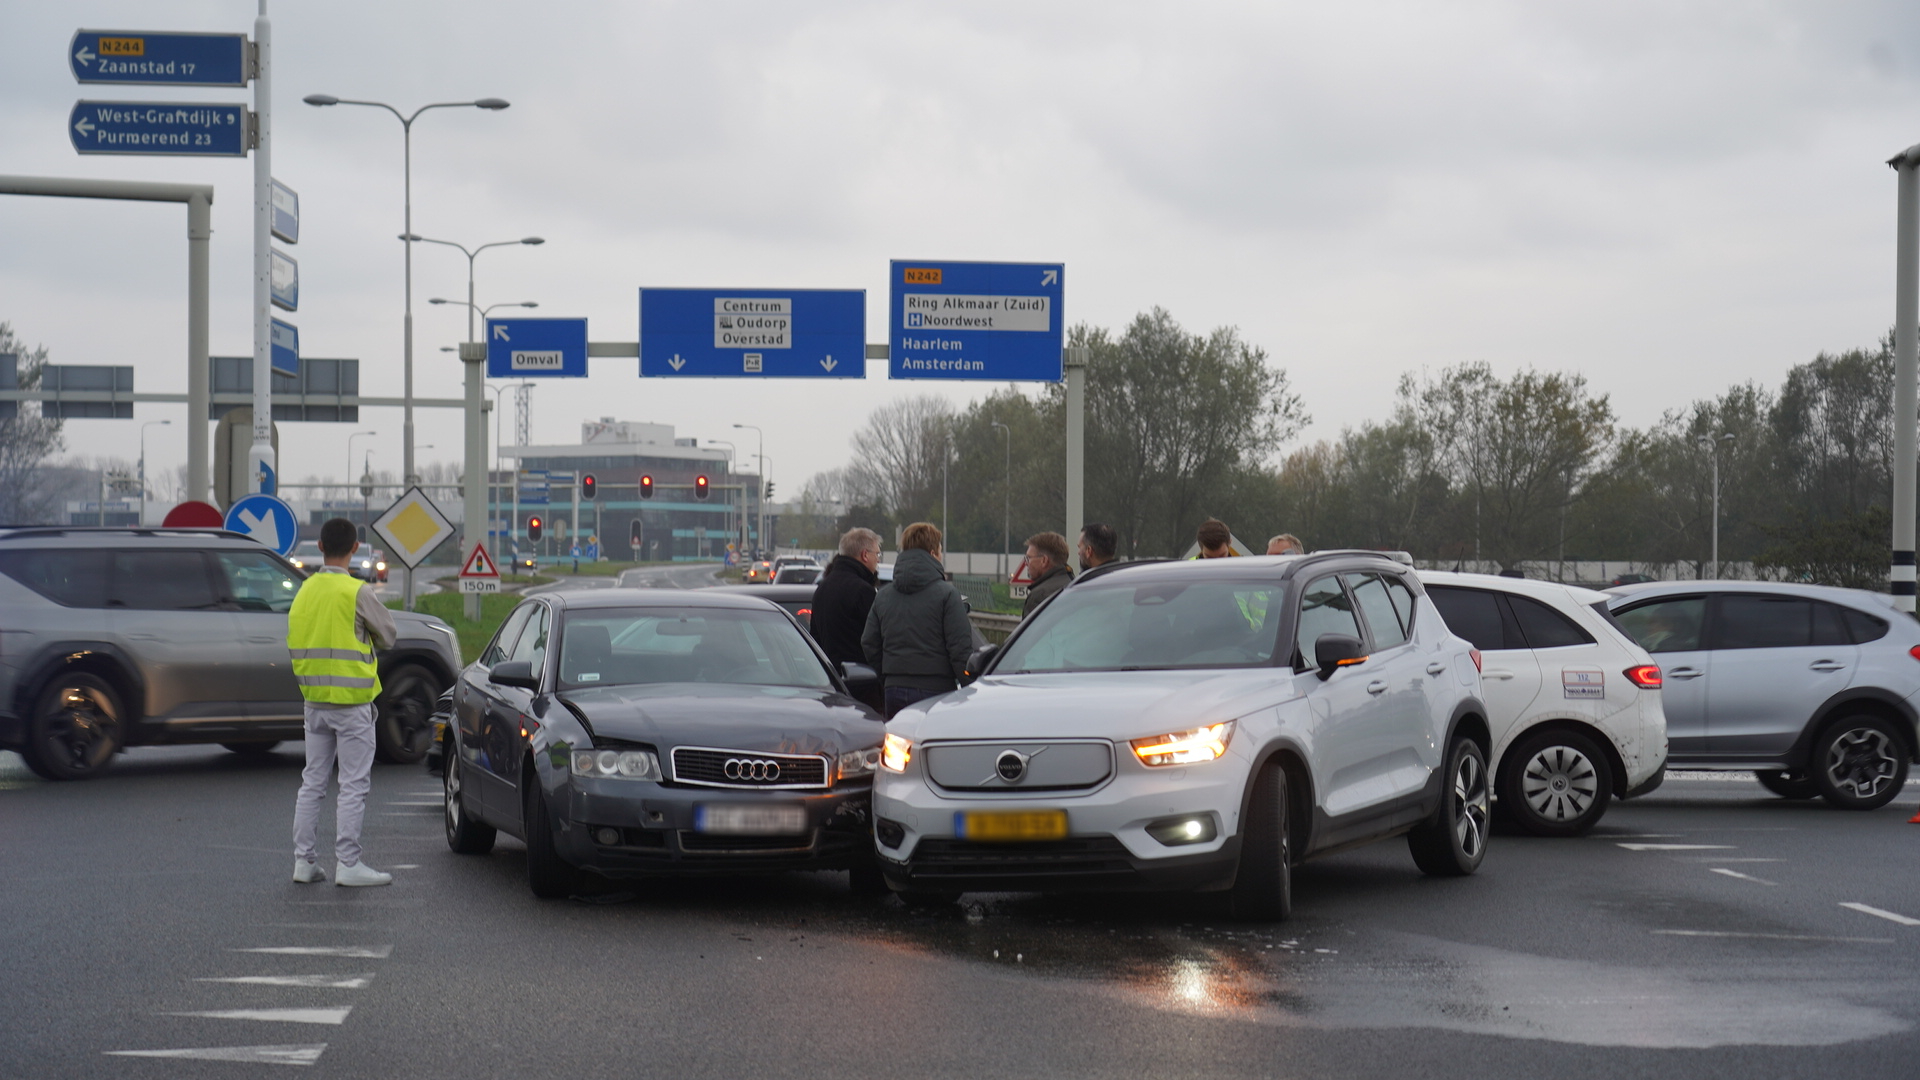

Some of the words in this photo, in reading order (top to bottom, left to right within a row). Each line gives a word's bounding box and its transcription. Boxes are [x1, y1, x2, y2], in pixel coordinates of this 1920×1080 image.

[98, 59, 175, 74] Zaanstad
[180, 63, 195, 75] 17
[97, 108, 221, 128] West-Graftdijk
[226, 113, 235, 125] 9
[97, 129, 189, 145] Purmerend
[194, 134, 212, 145] 23
[723, 300, 781, 312] Centrum
[908, 297, 938, 311] Ring
[943, 298, 999, 310] Alkmaar
[1004, 298, 1045, 311] (Zuid)
[736, 317, 787, 330] Oudorp
[924, 314, 994, 327] Noordwest
[722, 332, 783, 344] Overstad
[902, 337, 962, 350] Haarlem
[516, 353, 558, 365] Omval
[902, 357, 984, 370] Amsterdam
[1577, 673, 1589, 682] 112
